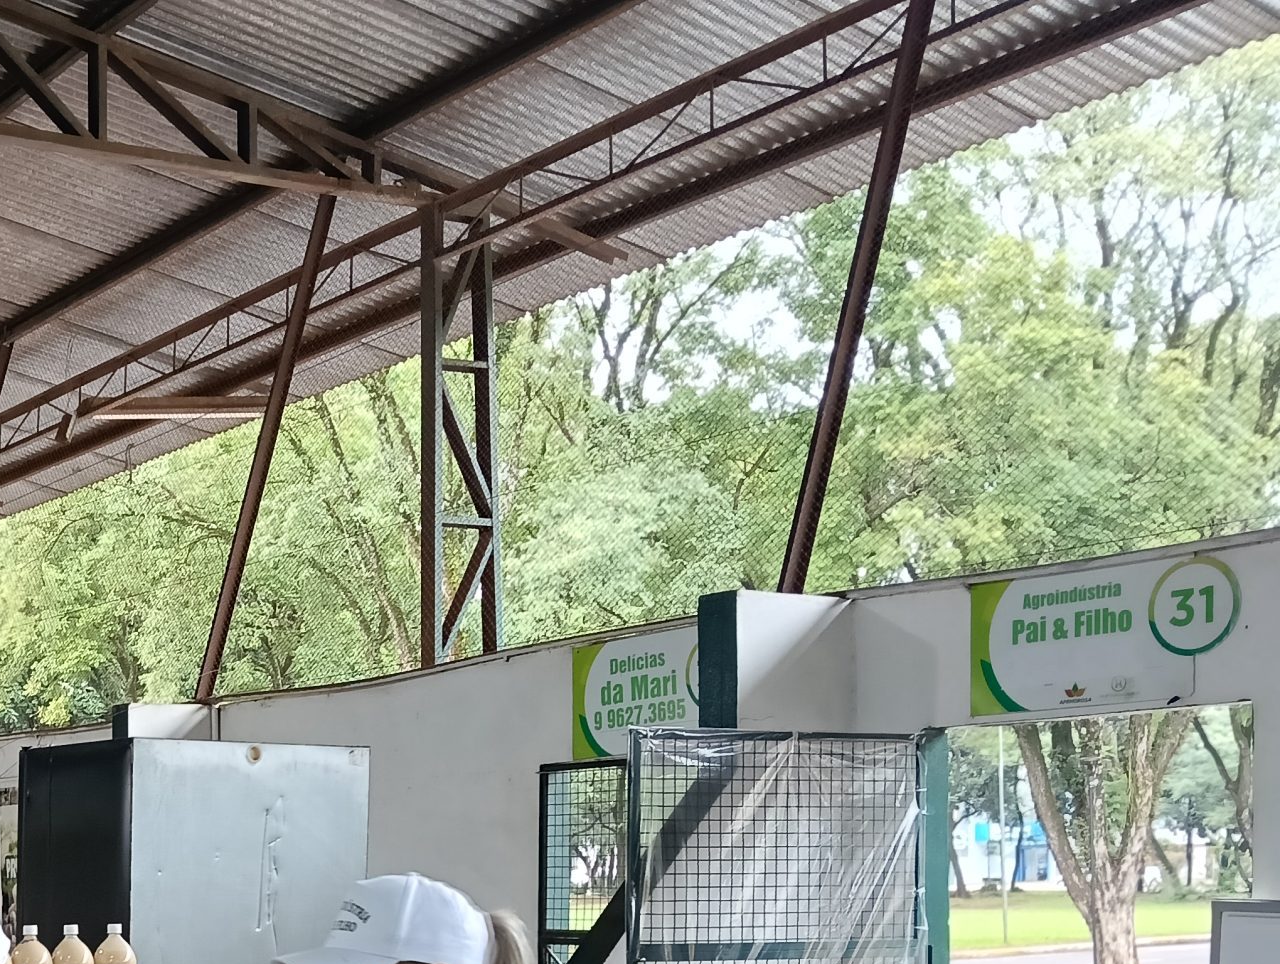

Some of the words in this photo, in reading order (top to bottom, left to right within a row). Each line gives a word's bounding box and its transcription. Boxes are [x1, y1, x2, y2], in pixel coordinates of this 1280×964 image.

[1022, 582, 1122, 610] Agroindústria
[1169, 585, 1214, 627] 31
[1011, 616, 1047, 646] Pai
[1052, 617, 1068, 641] &
[1074, 607, 1133, 638] Filho
[609, 652, 665, 675] Delícias
[600, 681, 624, 706] da
[631, 670, 677, 701] Mari
[594, 711, 603, 731] 9
[607, 699, 686, 728] 9627.3695
